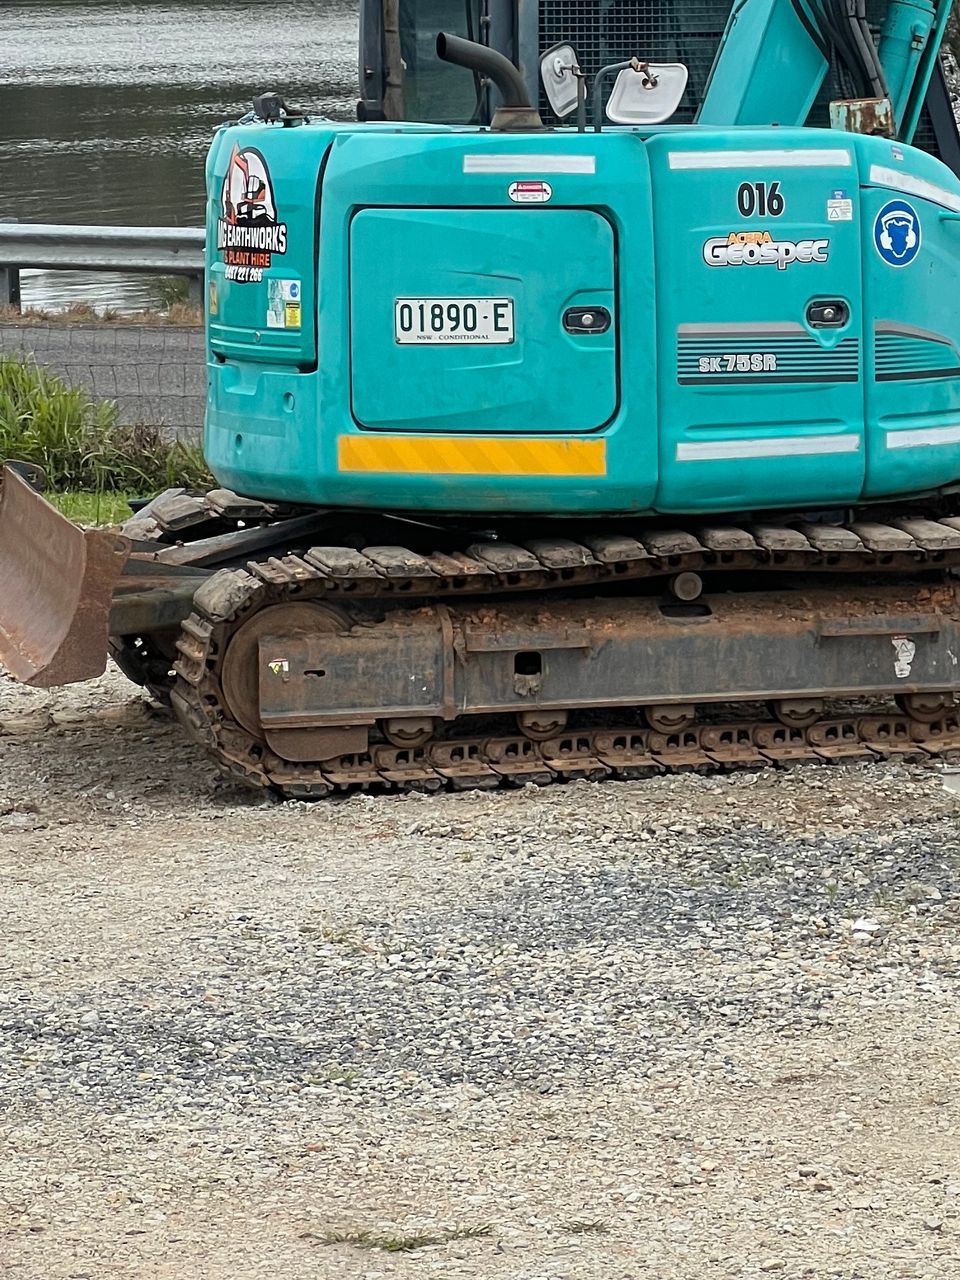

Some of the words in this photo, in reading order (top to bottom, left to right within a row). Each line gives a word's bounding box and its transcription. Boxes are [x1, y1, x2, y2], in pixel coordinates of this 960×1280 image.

[737, 182, 784, 217] 016
[227, 225, 286, 253] EARTHWORKS
[229, 251, 250, 265] PLANT
[251, 253, 270, 266] HIRE
